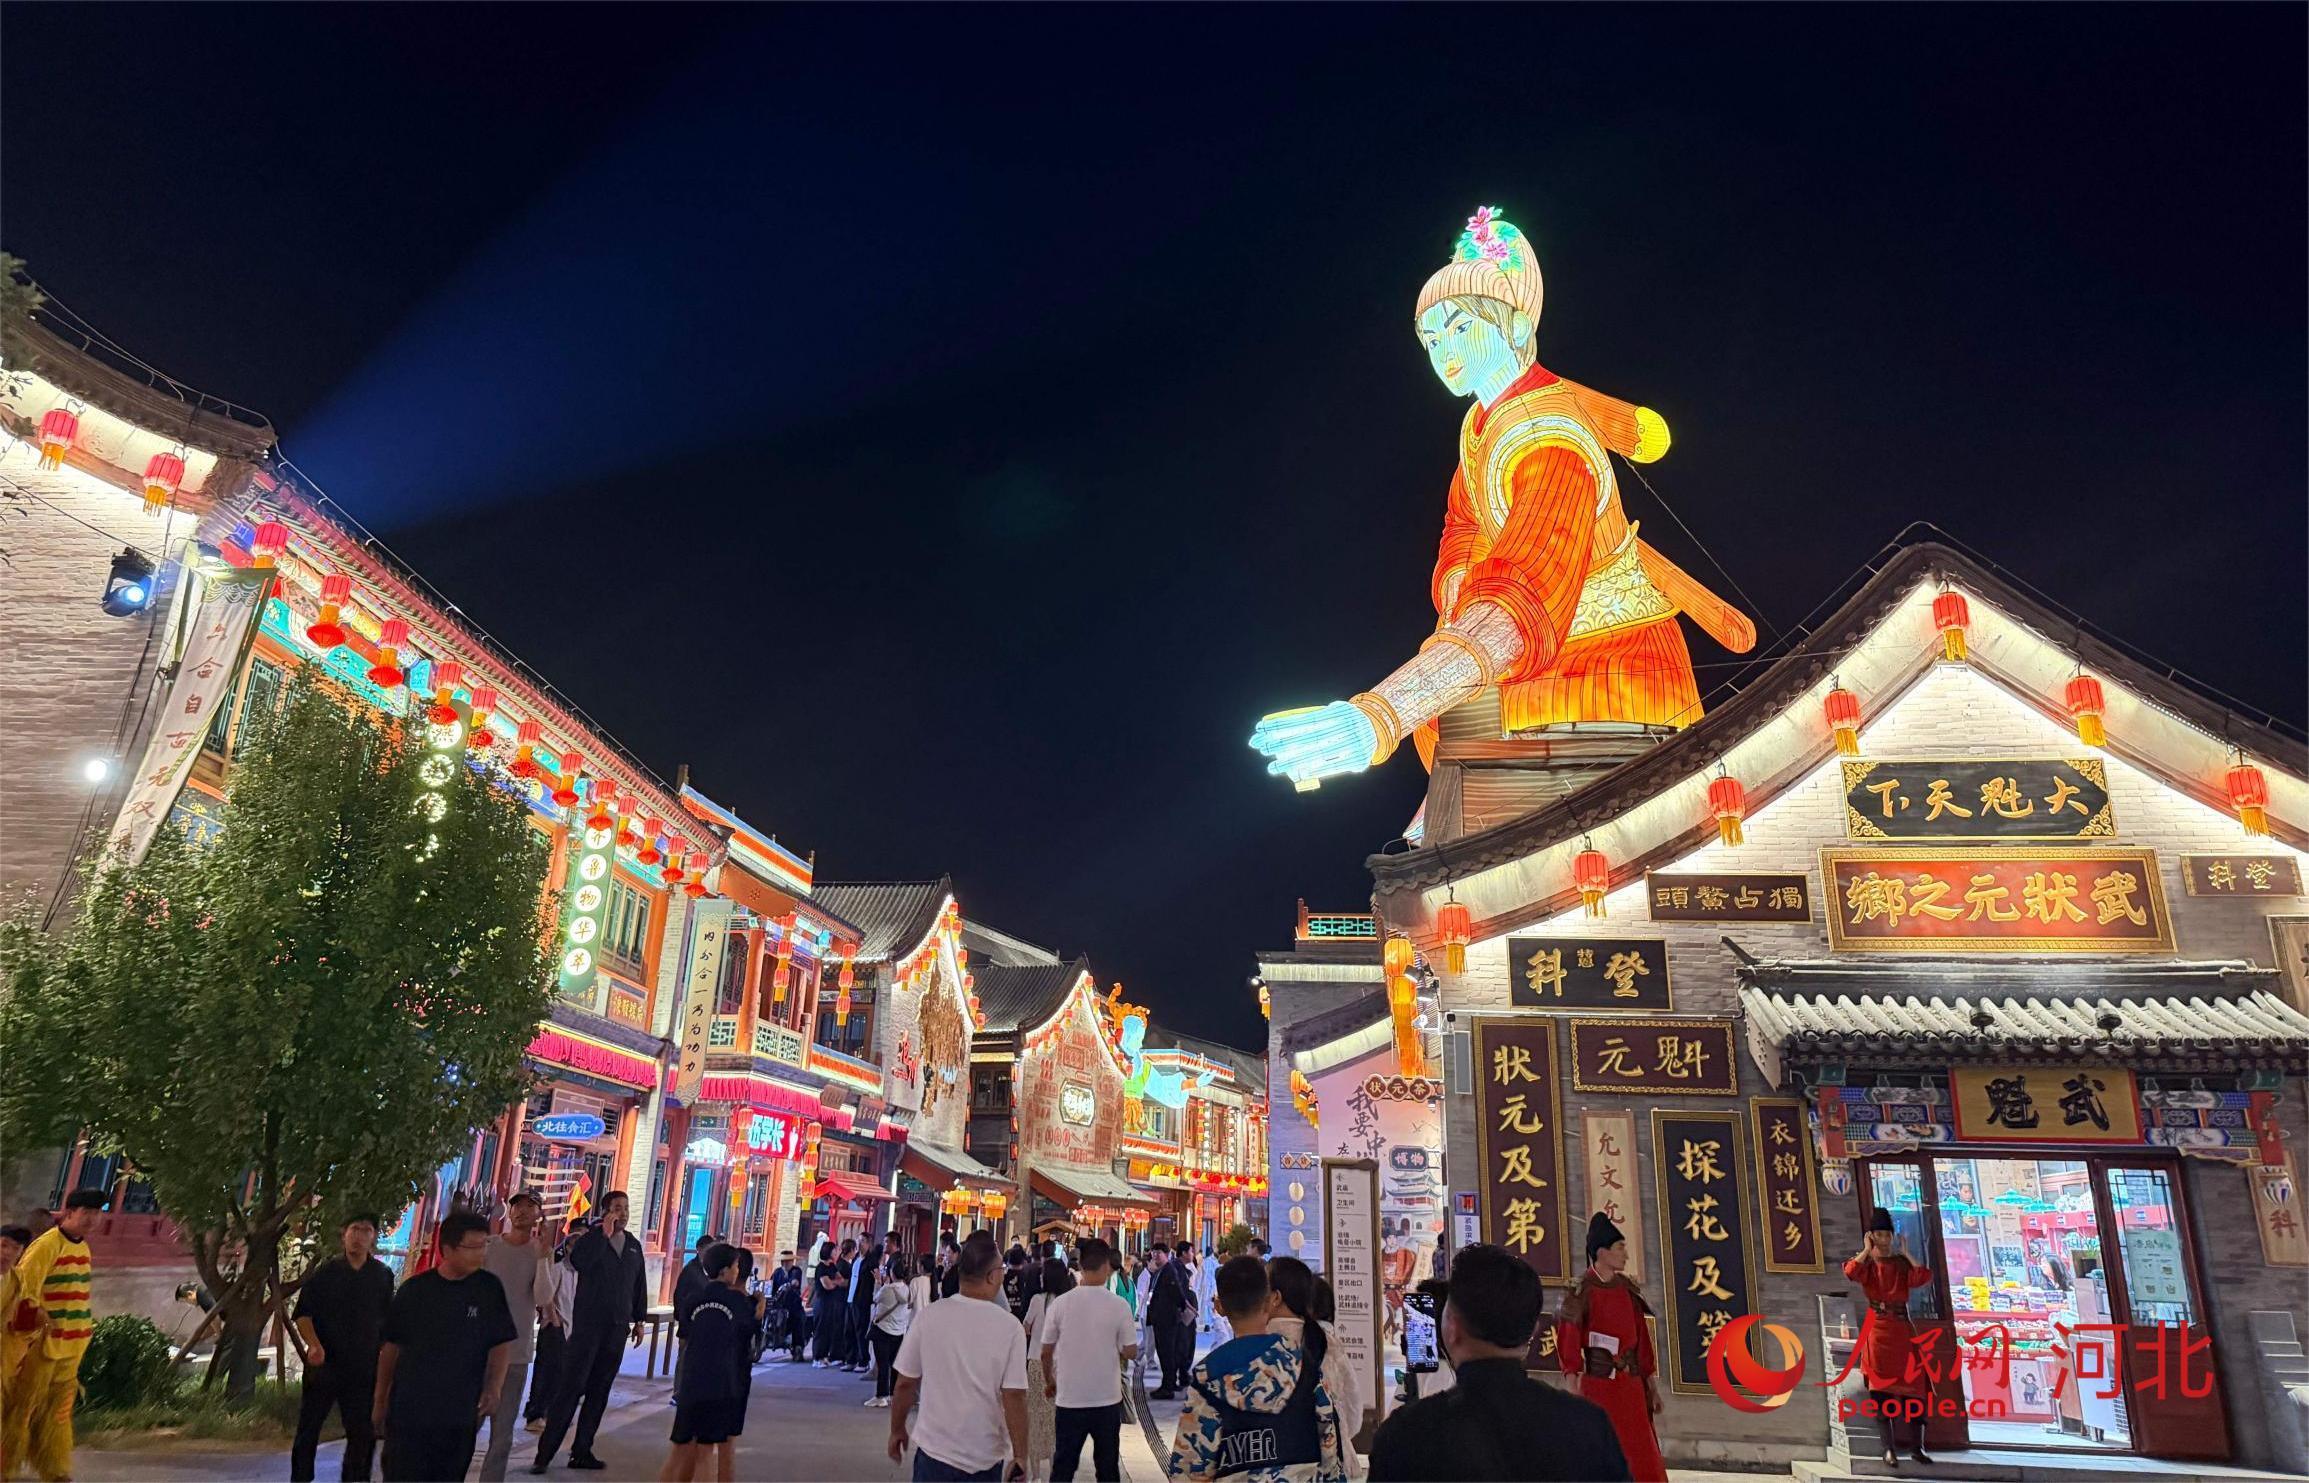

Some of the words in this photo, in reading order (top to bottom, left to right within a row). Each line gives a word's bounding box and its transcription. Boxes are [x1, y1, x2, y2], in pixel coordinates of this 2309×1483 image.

[1768, 1119, 1805, 1251] 衣锦还乡
[1336, 1199, 1355, 1208] 卫生间
[2269, 1210, 2298, 1239] 科
[1338, 1279, 1363, 1287] 景区出口
